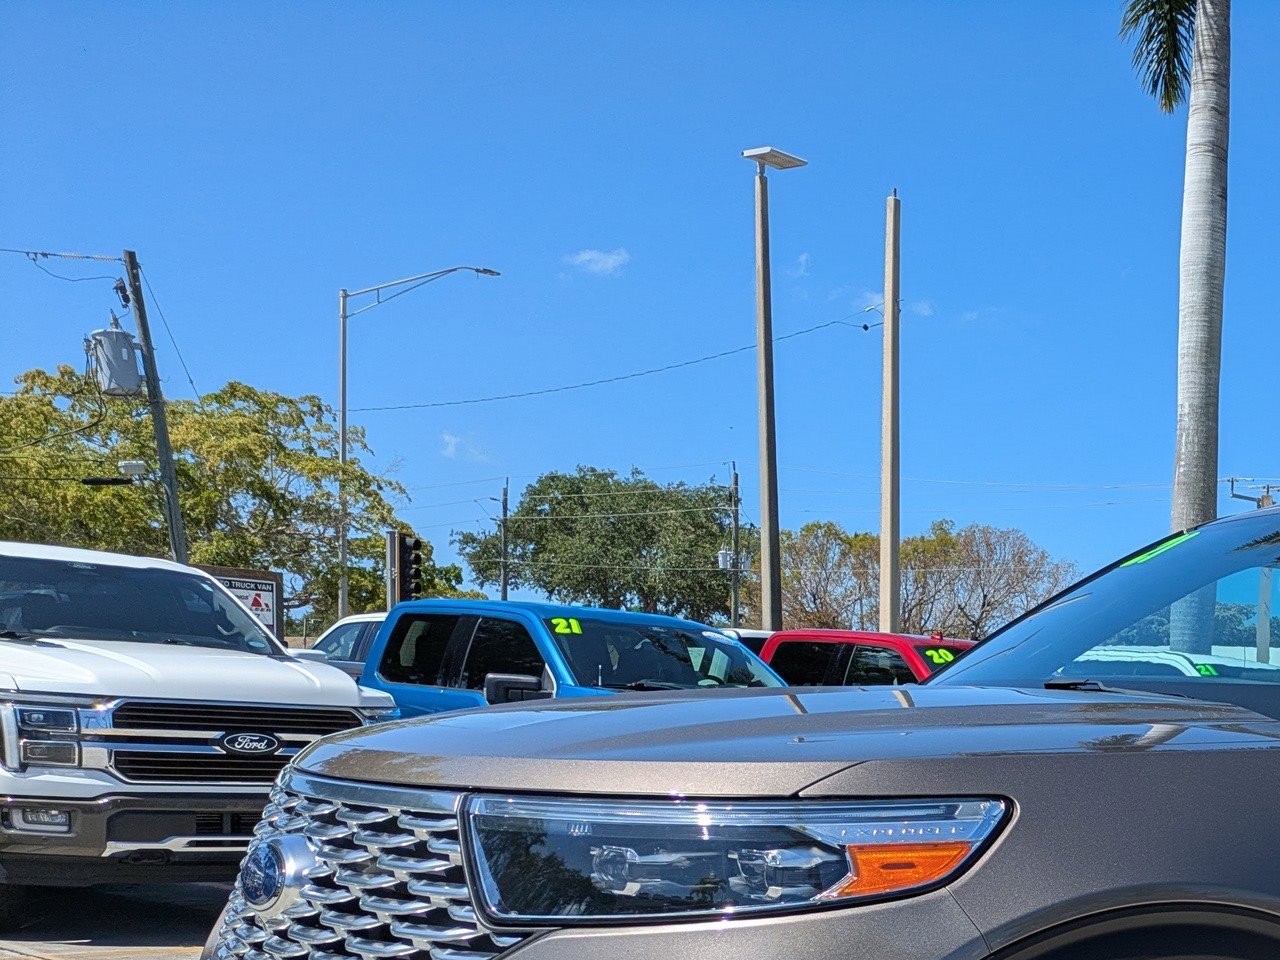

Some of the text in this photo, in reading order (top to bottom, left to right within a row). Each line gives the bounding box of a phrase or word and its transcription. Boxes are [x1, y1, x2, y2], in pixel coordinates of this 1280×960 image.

[232, 581, 256, 590] TRUCK
[257, 583, 272, 591] VAN
[551, 618, 582, 635] 21
[925, 648, 954, 664] 20
[1195, 664, 1219, 676] 21
[234, 735, 268, 749] Ford
